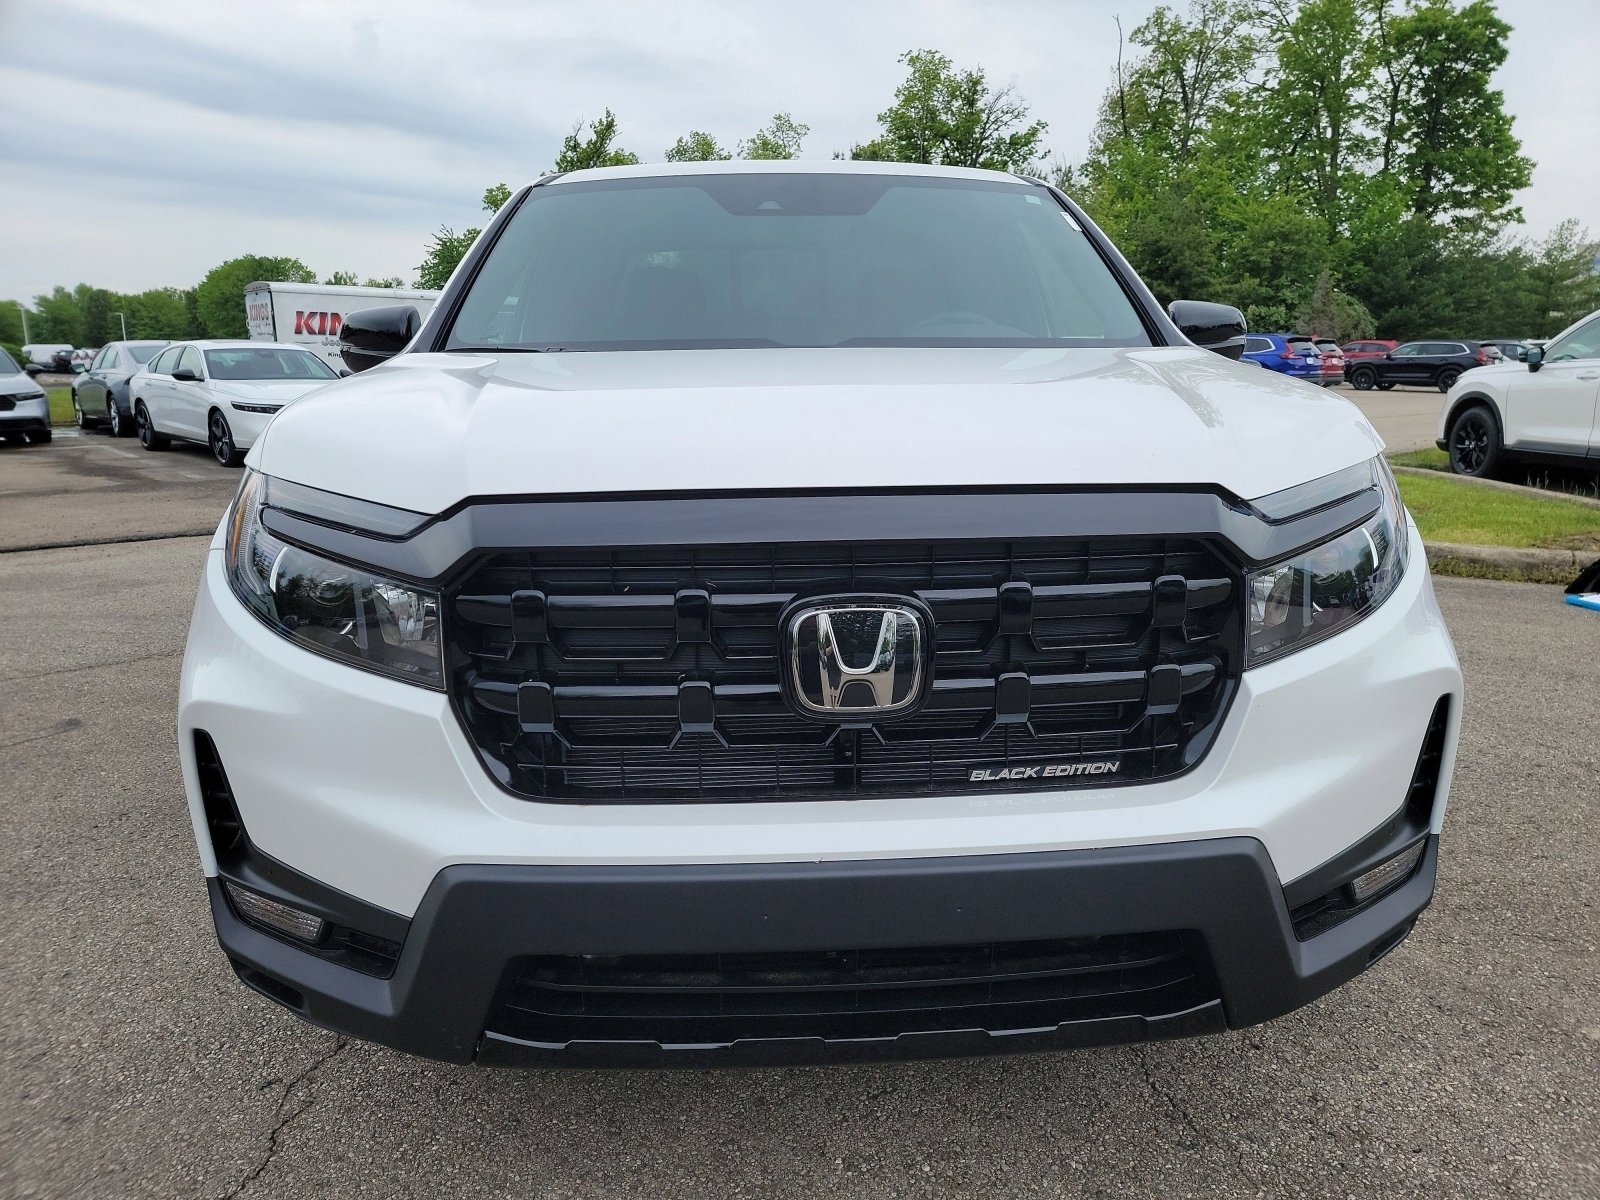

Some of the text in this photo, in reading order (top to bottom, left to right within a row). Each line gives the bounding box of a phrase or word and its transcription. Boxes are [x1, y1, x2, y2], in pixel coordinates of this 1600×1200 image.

[249, 303, 269, 321] KINGS
[294, 311, 345, 335] KIN
[321, 338, 342, 346] Jee
[970, 761, 1120, 781] BLACK EDITION
